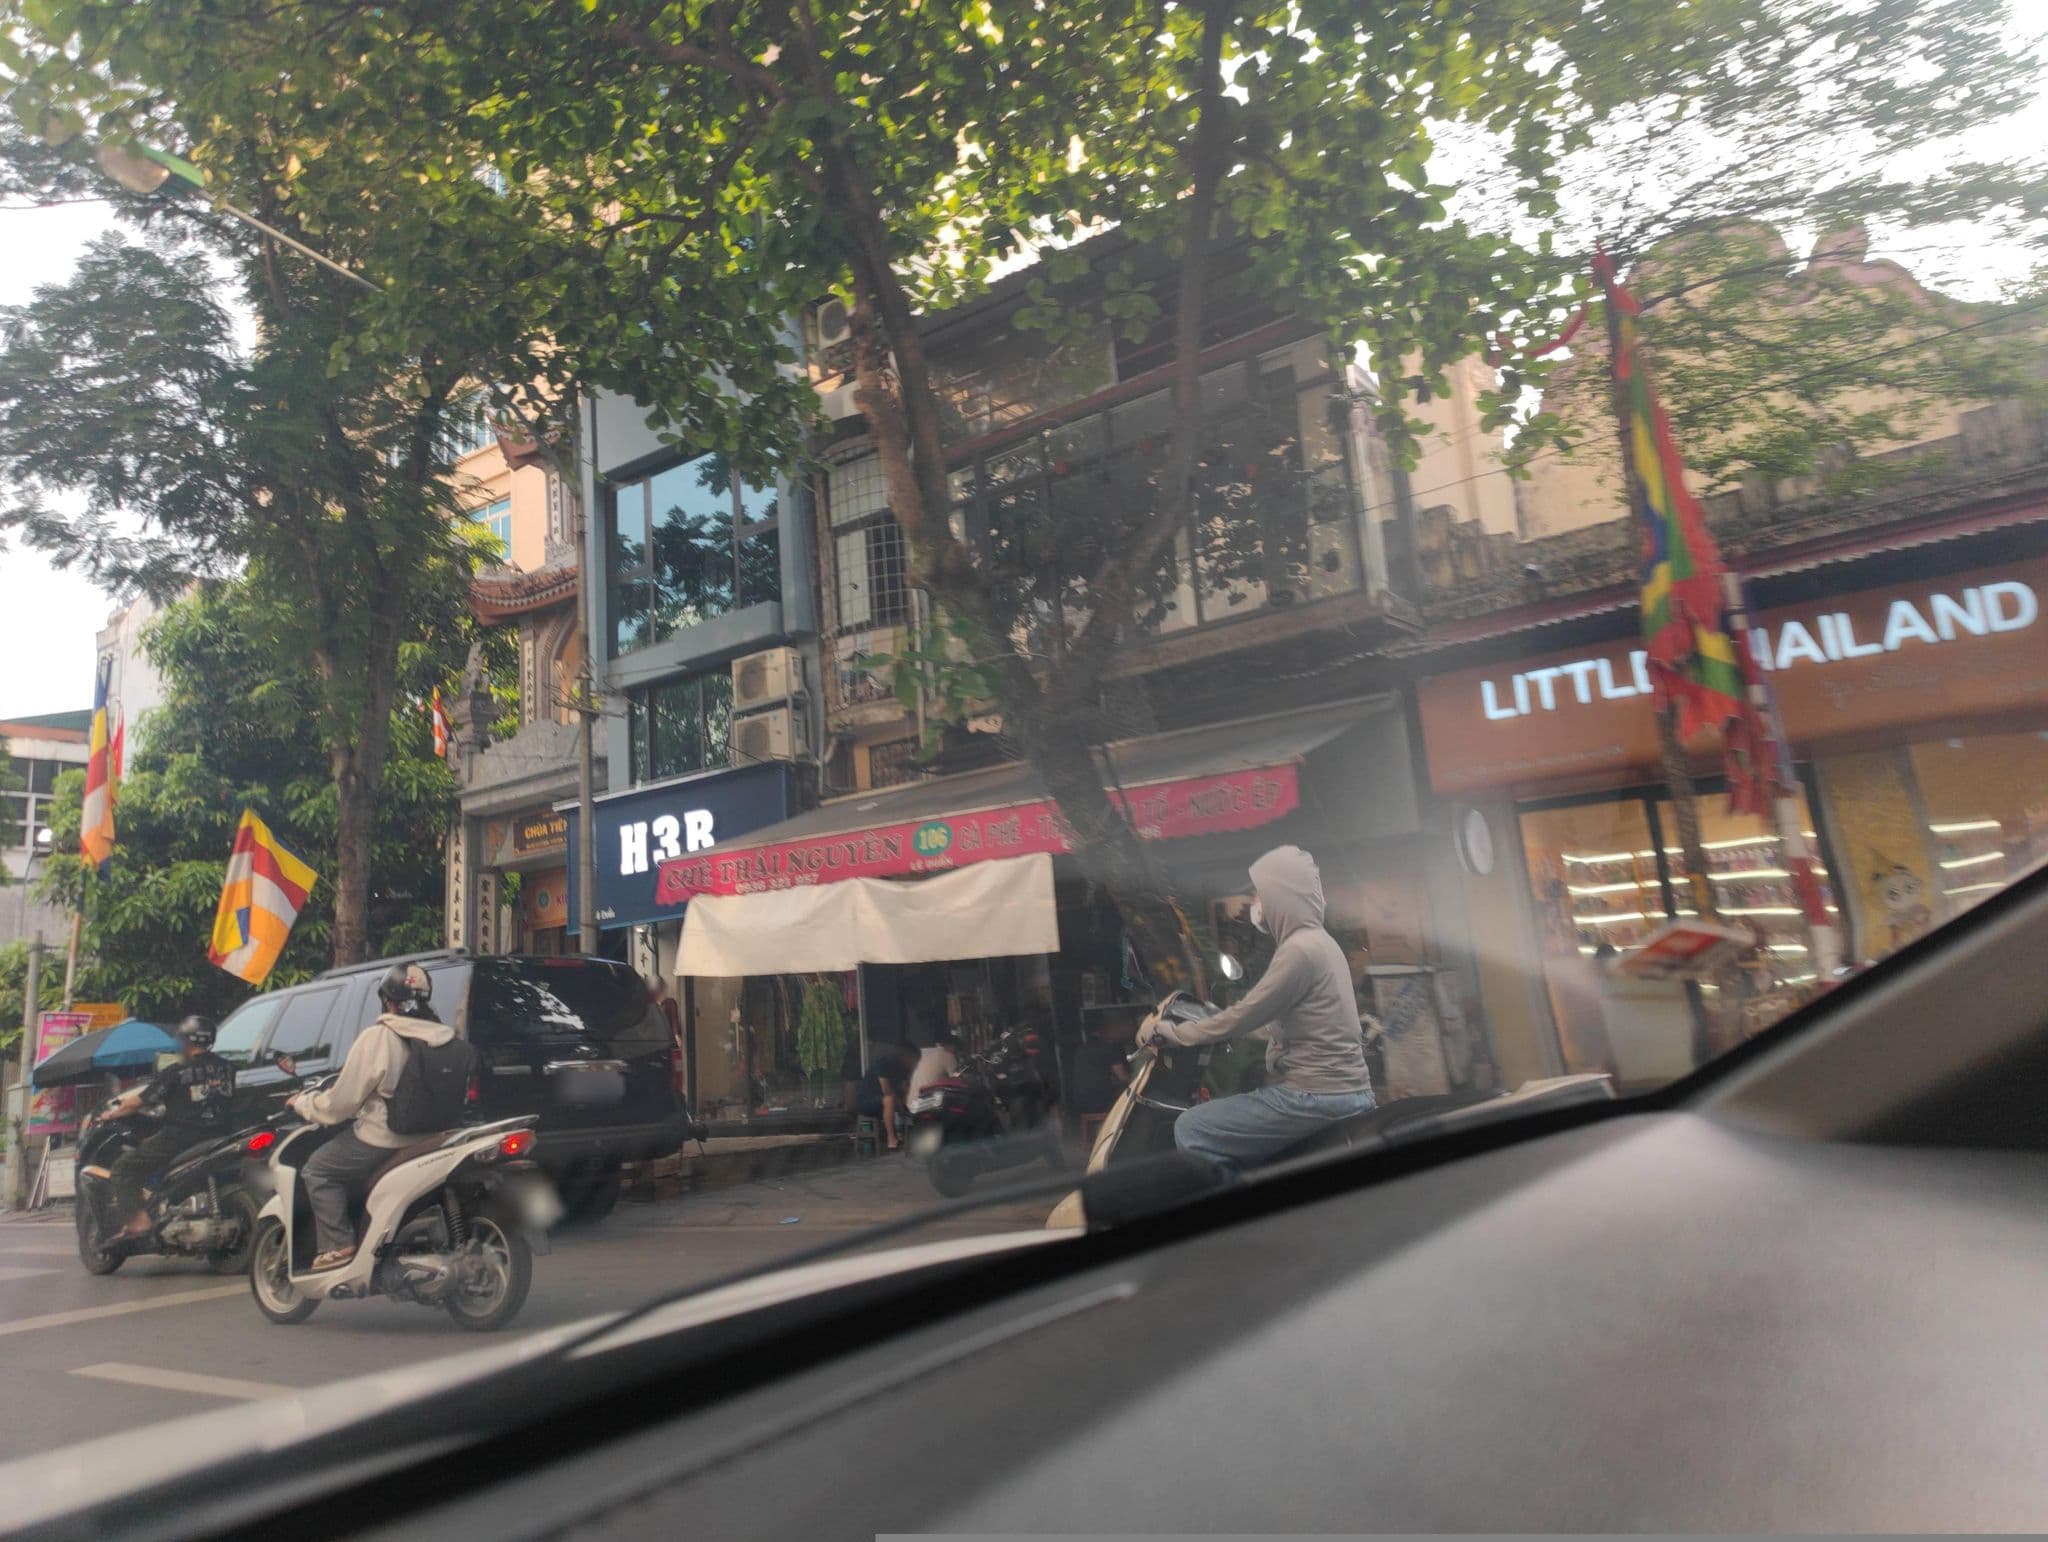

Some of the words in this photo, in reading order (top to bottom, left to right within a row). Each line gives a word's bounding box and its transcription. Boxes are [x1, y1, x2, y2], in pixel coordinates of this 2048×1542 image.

[619, 809, 715, 876] H3R
[918, 826, 949, 851] 106
[665, 857, 712, 891] CHÈ
[719, 849, 779, 884] THÁI
